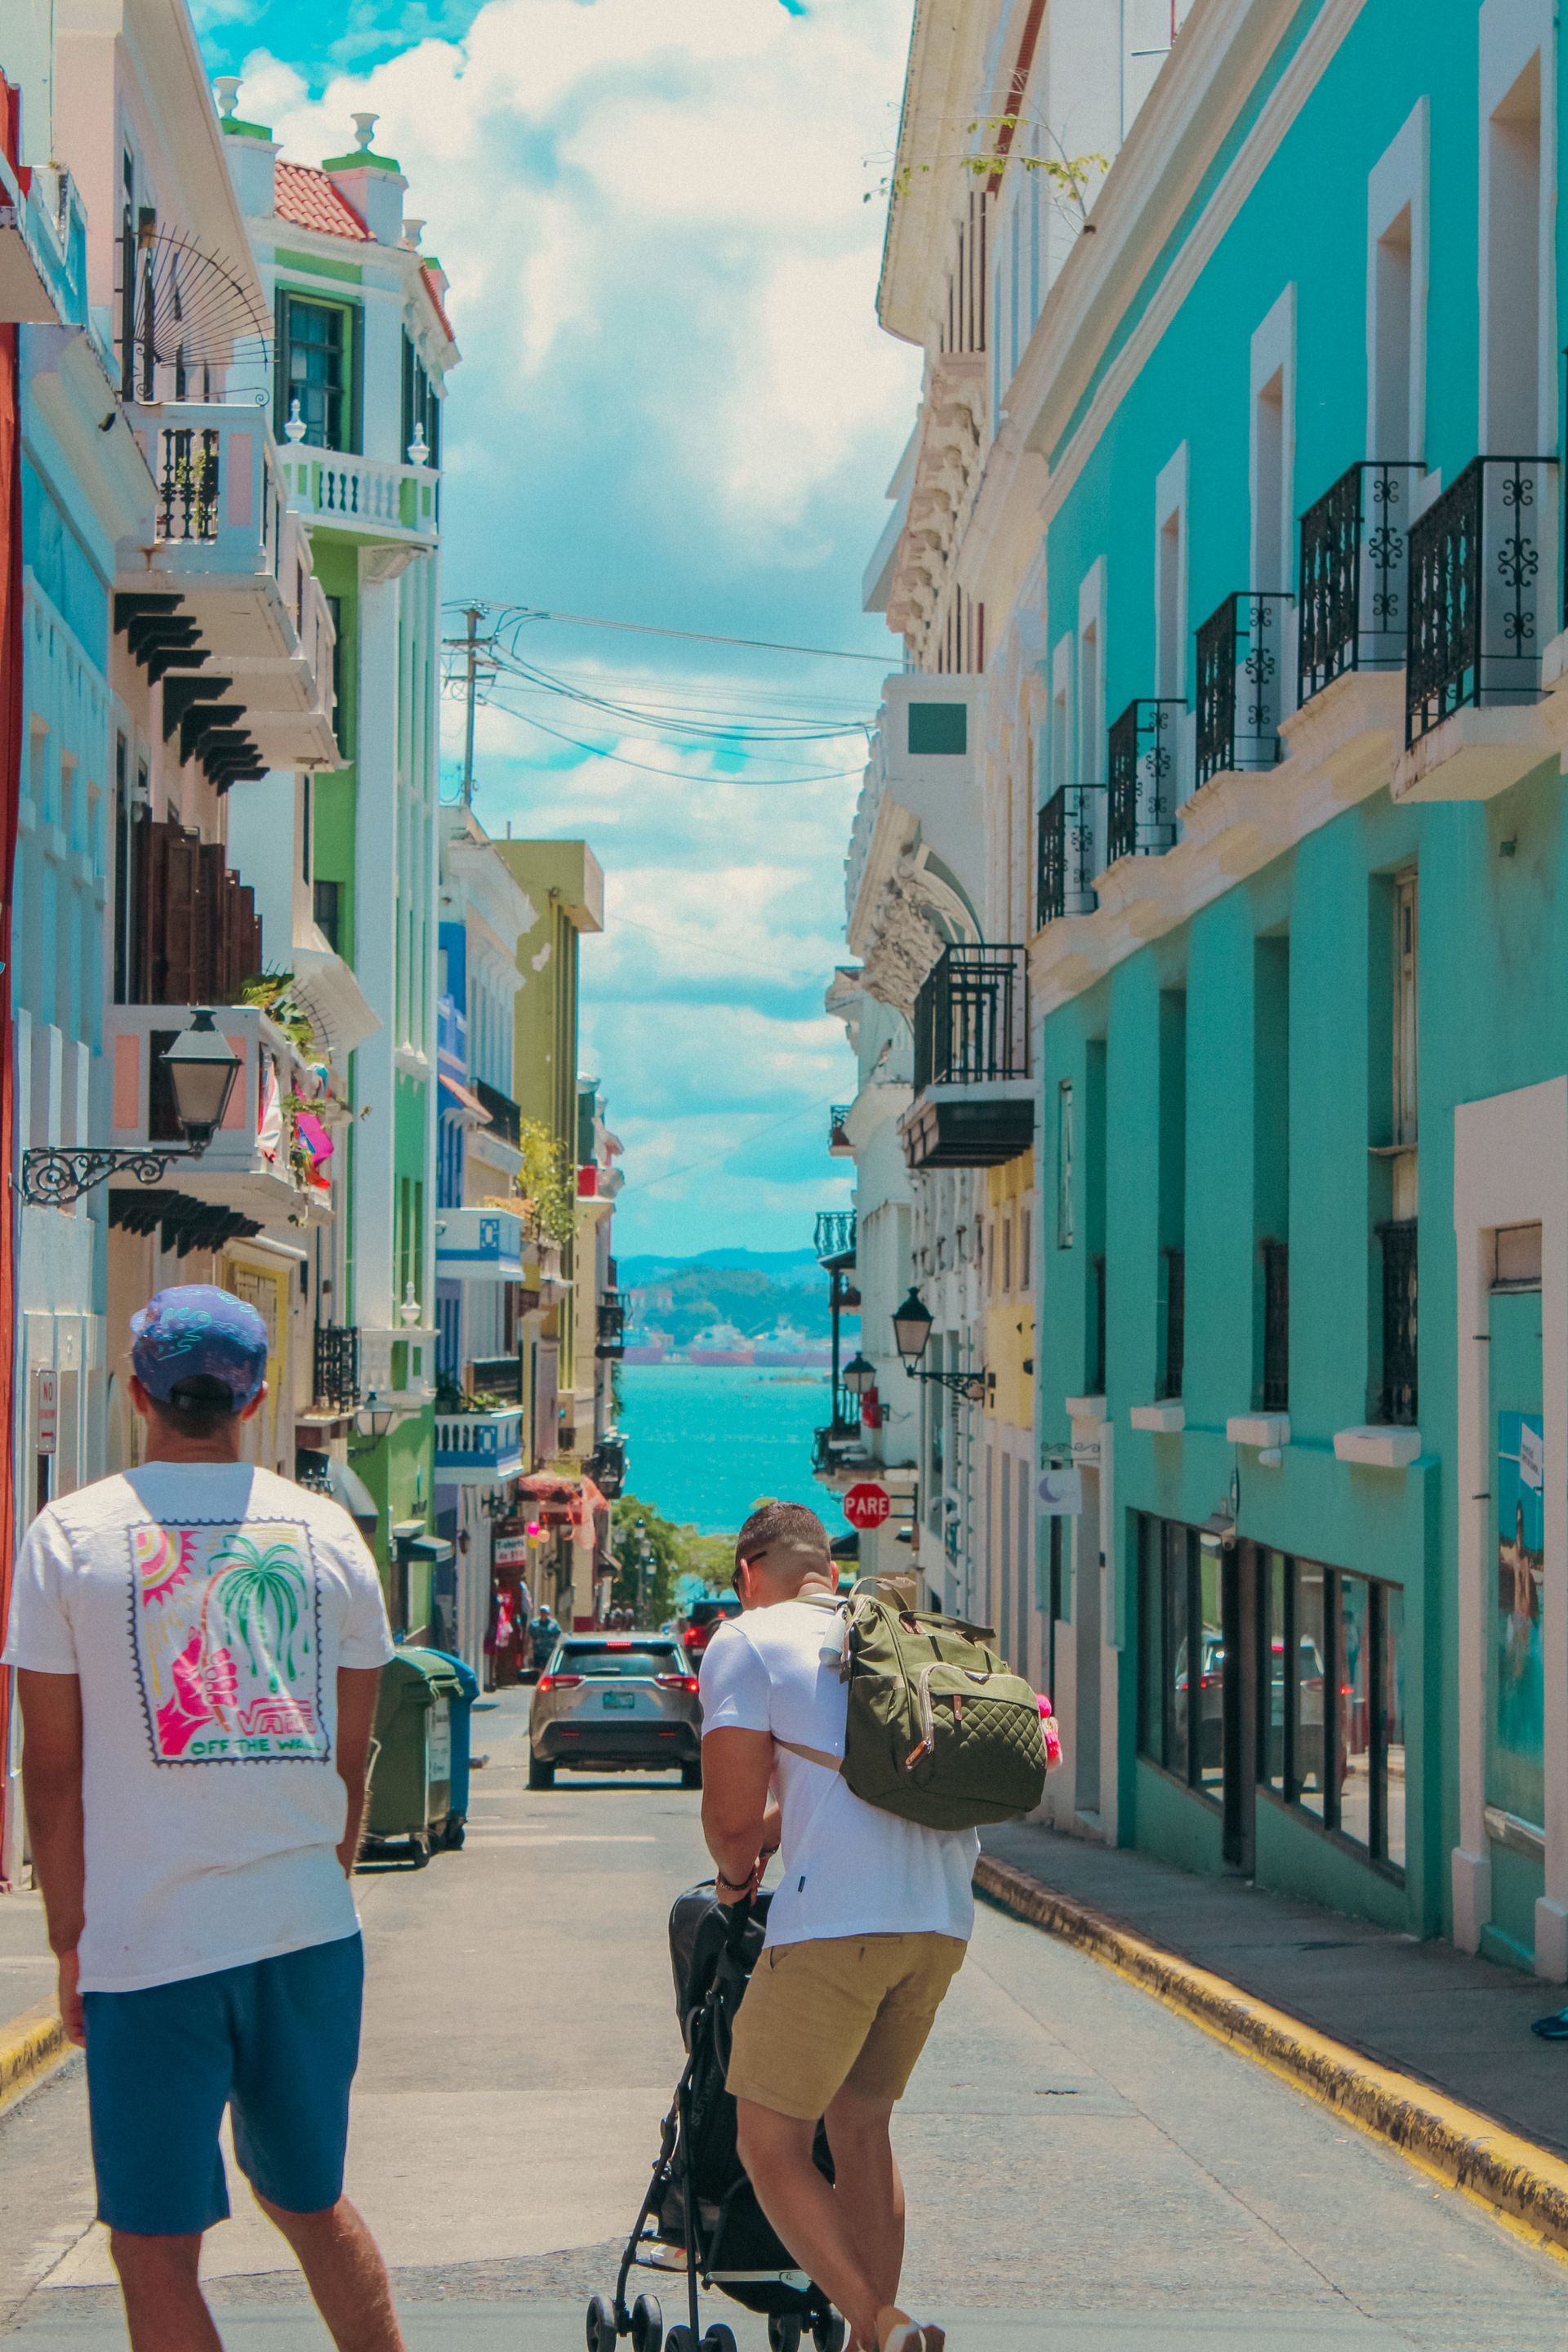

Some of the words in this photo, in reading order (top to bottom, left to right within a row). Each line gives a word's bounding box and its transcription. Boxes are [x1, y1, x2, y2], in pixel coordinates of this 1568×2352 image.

[43, 1382, 53, 1401] NO
[845, 1497, 888, 1515] PARE
[190, 1740, 229, 1755] OFF
[235, 1738, 270, 1753] THE
[277, 1738, 322, 1751] WA
